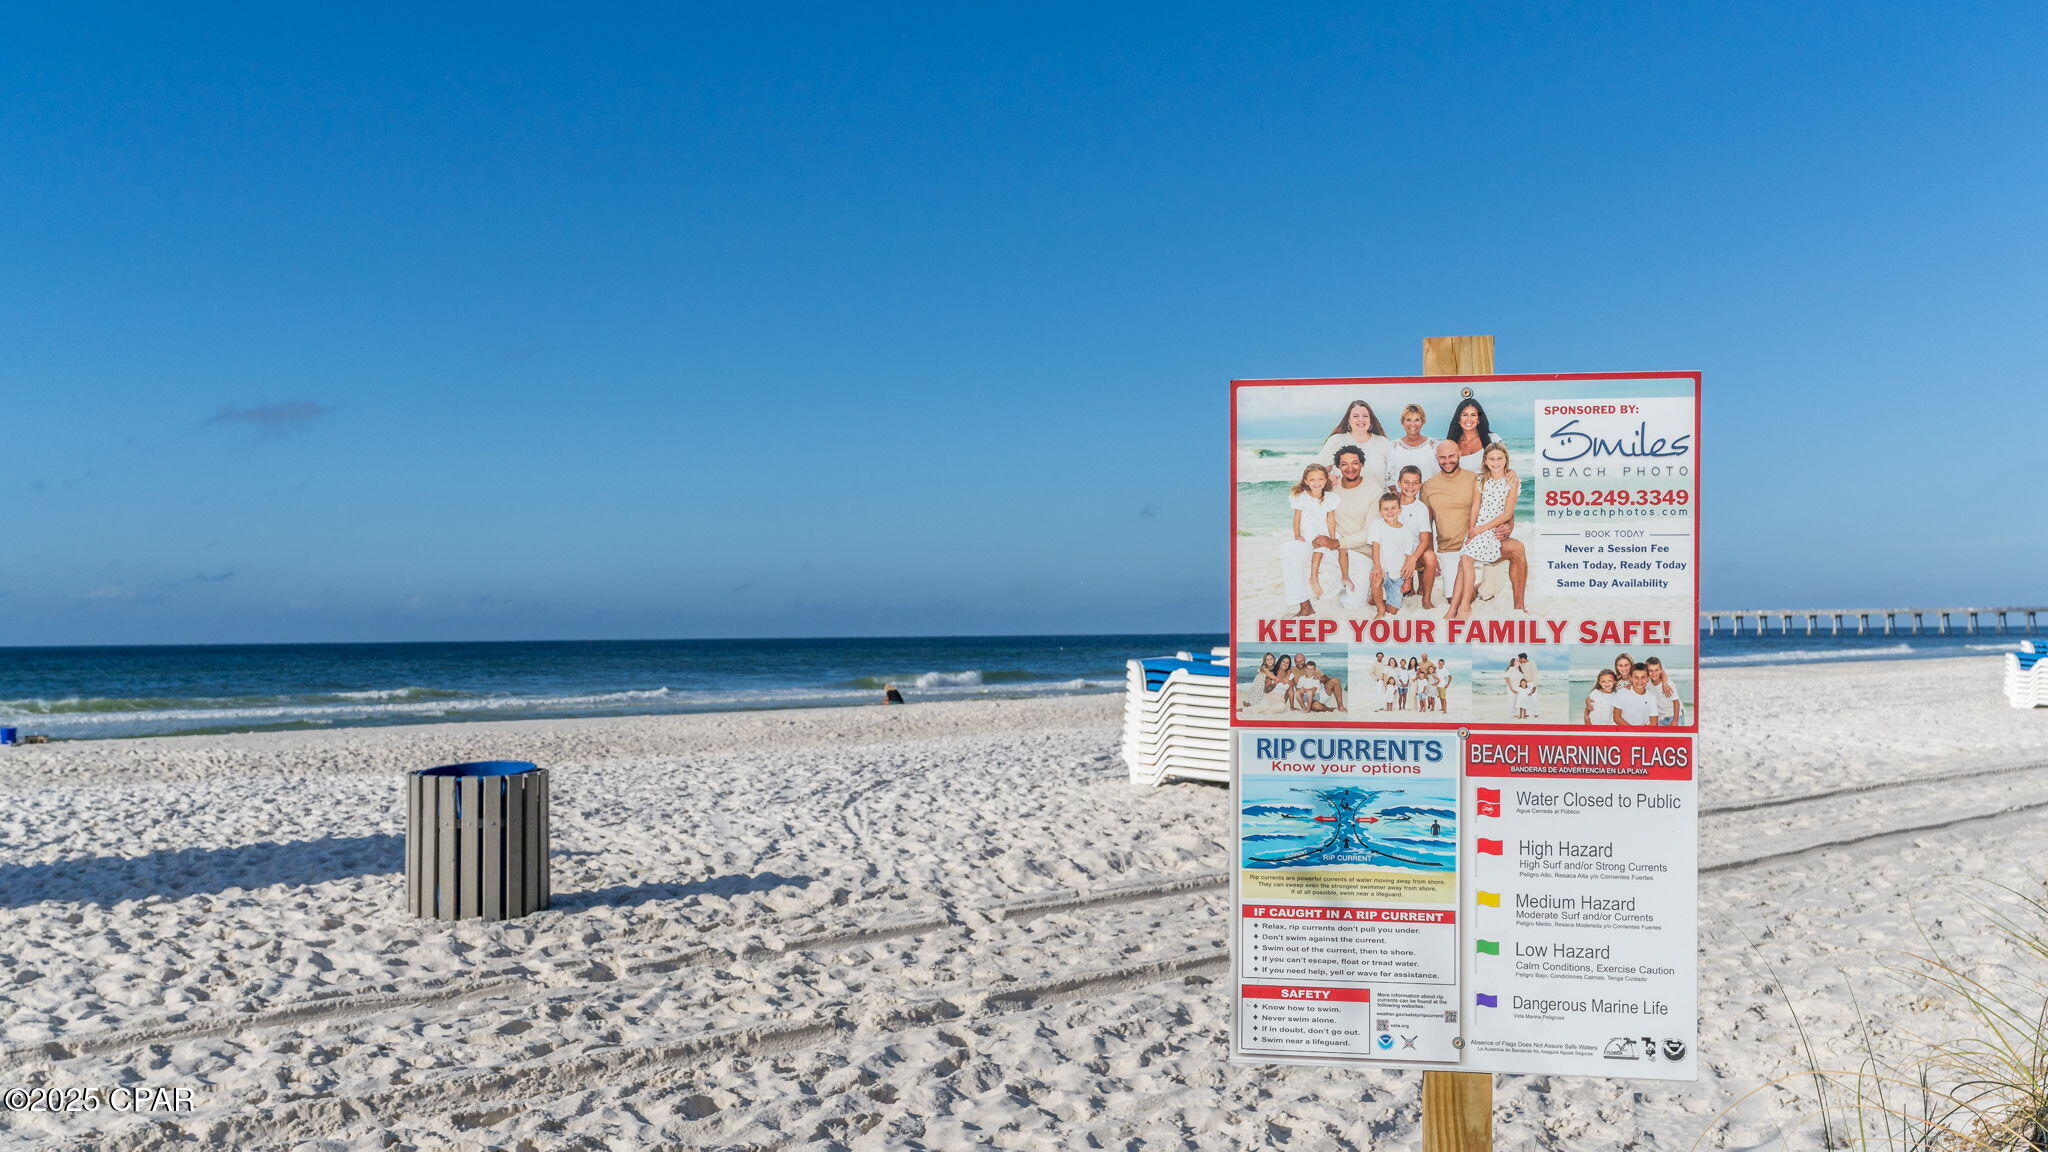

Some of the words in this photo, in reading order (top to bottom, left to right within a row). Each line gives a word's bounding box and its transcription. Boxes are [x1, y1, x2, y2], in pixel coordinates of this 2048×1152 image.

[1544, 405, 1616, 415] SPONSORED
[1620, 405, 1638, 413] BY:
[1542, 419, 1690, 461] Smiles
[1542, 467, 1605, 477] BEACH
[1623, 466, 1688, 477] PHOTO
[1545, 489, 1689, 506] 850.249.3349
[1547, 508, 1688, 518] mybeachphotos.com
[1564, 544, 1594, 552] Never
[1607, 544, 1646, 552] Session
[1651, 544, 1669, 552] Fee
[1547, 561, 1578, 569] Taken
[1582, 561, 1616, 570] Today,
[1620, 561, 1651, 570] Ready
[1655, 561, 1687, 570] Today
[1556, 579, 1585, 587] Same
[1589, 579, 1608, 588] Day
[1611, 579, 1668, 588] Availability
[1258, 619, 1338, 642] KEEP
[1349, 619, 1435, 643] YOUR
[1448, 619, 1568, 643] FAMILY
[1579, 620, 1671, 644] SAFE!
[1256, 738, 1296, 760] RIP
[1300, 738, 1444, 763] CURRENTS
[1471, 744, 1529, 764] BEACH
[1538, 745, 1621, 766] WARNING
[1631, 747, 1688, 768] FLAGS
[1272, 761, 1315, 772] Know
[1321, 763, 1356, 774] your
[1361, 763, 1421, 776] options
[1516, 791, 1559, 806] Water
[1563, 792, 1613, 807] Closed
[1618, 793, 1631, 808] to
[1637, 793, 1681, 809] Public
[1519, 840, 1552, 860] High
[1559, 841, 1612, 858] Hazard
[1519, 860, 1540, 870] High
[1542, 860, 1561, 869] Surf
[1563, 860, 1593, 870] and/or
[1595, 861, 1625, 872] Strong
[1628, 862, 1667, 872] Currents
[1322, 876, 1347, 884] currents
[1516, 894, 1575, 909] Medium
[1581, 895, 1635, 911] Hazard
[1254, 908, 1265, 916] IF
[1269, 908, 1322, 918] CAUGHT
[1326, 910, 1339, 918] IN
[1343, 910, 1352, 919] A
[1356, 911, 1377, 919] RIP
[1381, 911, 1443, 921] CURRENT
[1515, 911, 1558, 919] Moderate
[1561, 911, 1580, 920] Surf
[1582, 912, 1612, 920] and/or
[1614, 912, 1653, 922] Currents
[1516, 942, 1547, 957] Low
[1553, 943, 1609, 959] Hazard
[1308, 968, 1327, 976] help,
[1329, 969, 1344, 977] yell
[1393, 971, 1439, 979] assistance.
[1515, 961, 1539, 973] Calm
[1542, 962, 1593, 973] Conditions,
[1596, 963, 1636, 973] Exercise
[1638, 965, 1674, 975] Caution
[1281, 989, 1331, 999] SAFETY
[1513, 995, 1586, 1014] Dangerous
[1591, 998, 1638, 1014] Marine
[1643, 1000, 1668, 1015] Life
[1279, 1026, 1305, 1034] doubt,
[1312, 1039, 1350, 1047] lifeguard.
[1470, 1039, 1494, 1048] Absence
[1494, 1040, 1501, 1048] of
[1501, 1040, 1516, 1049] Flags
[1533, 1042, 1543, 1050] Not
